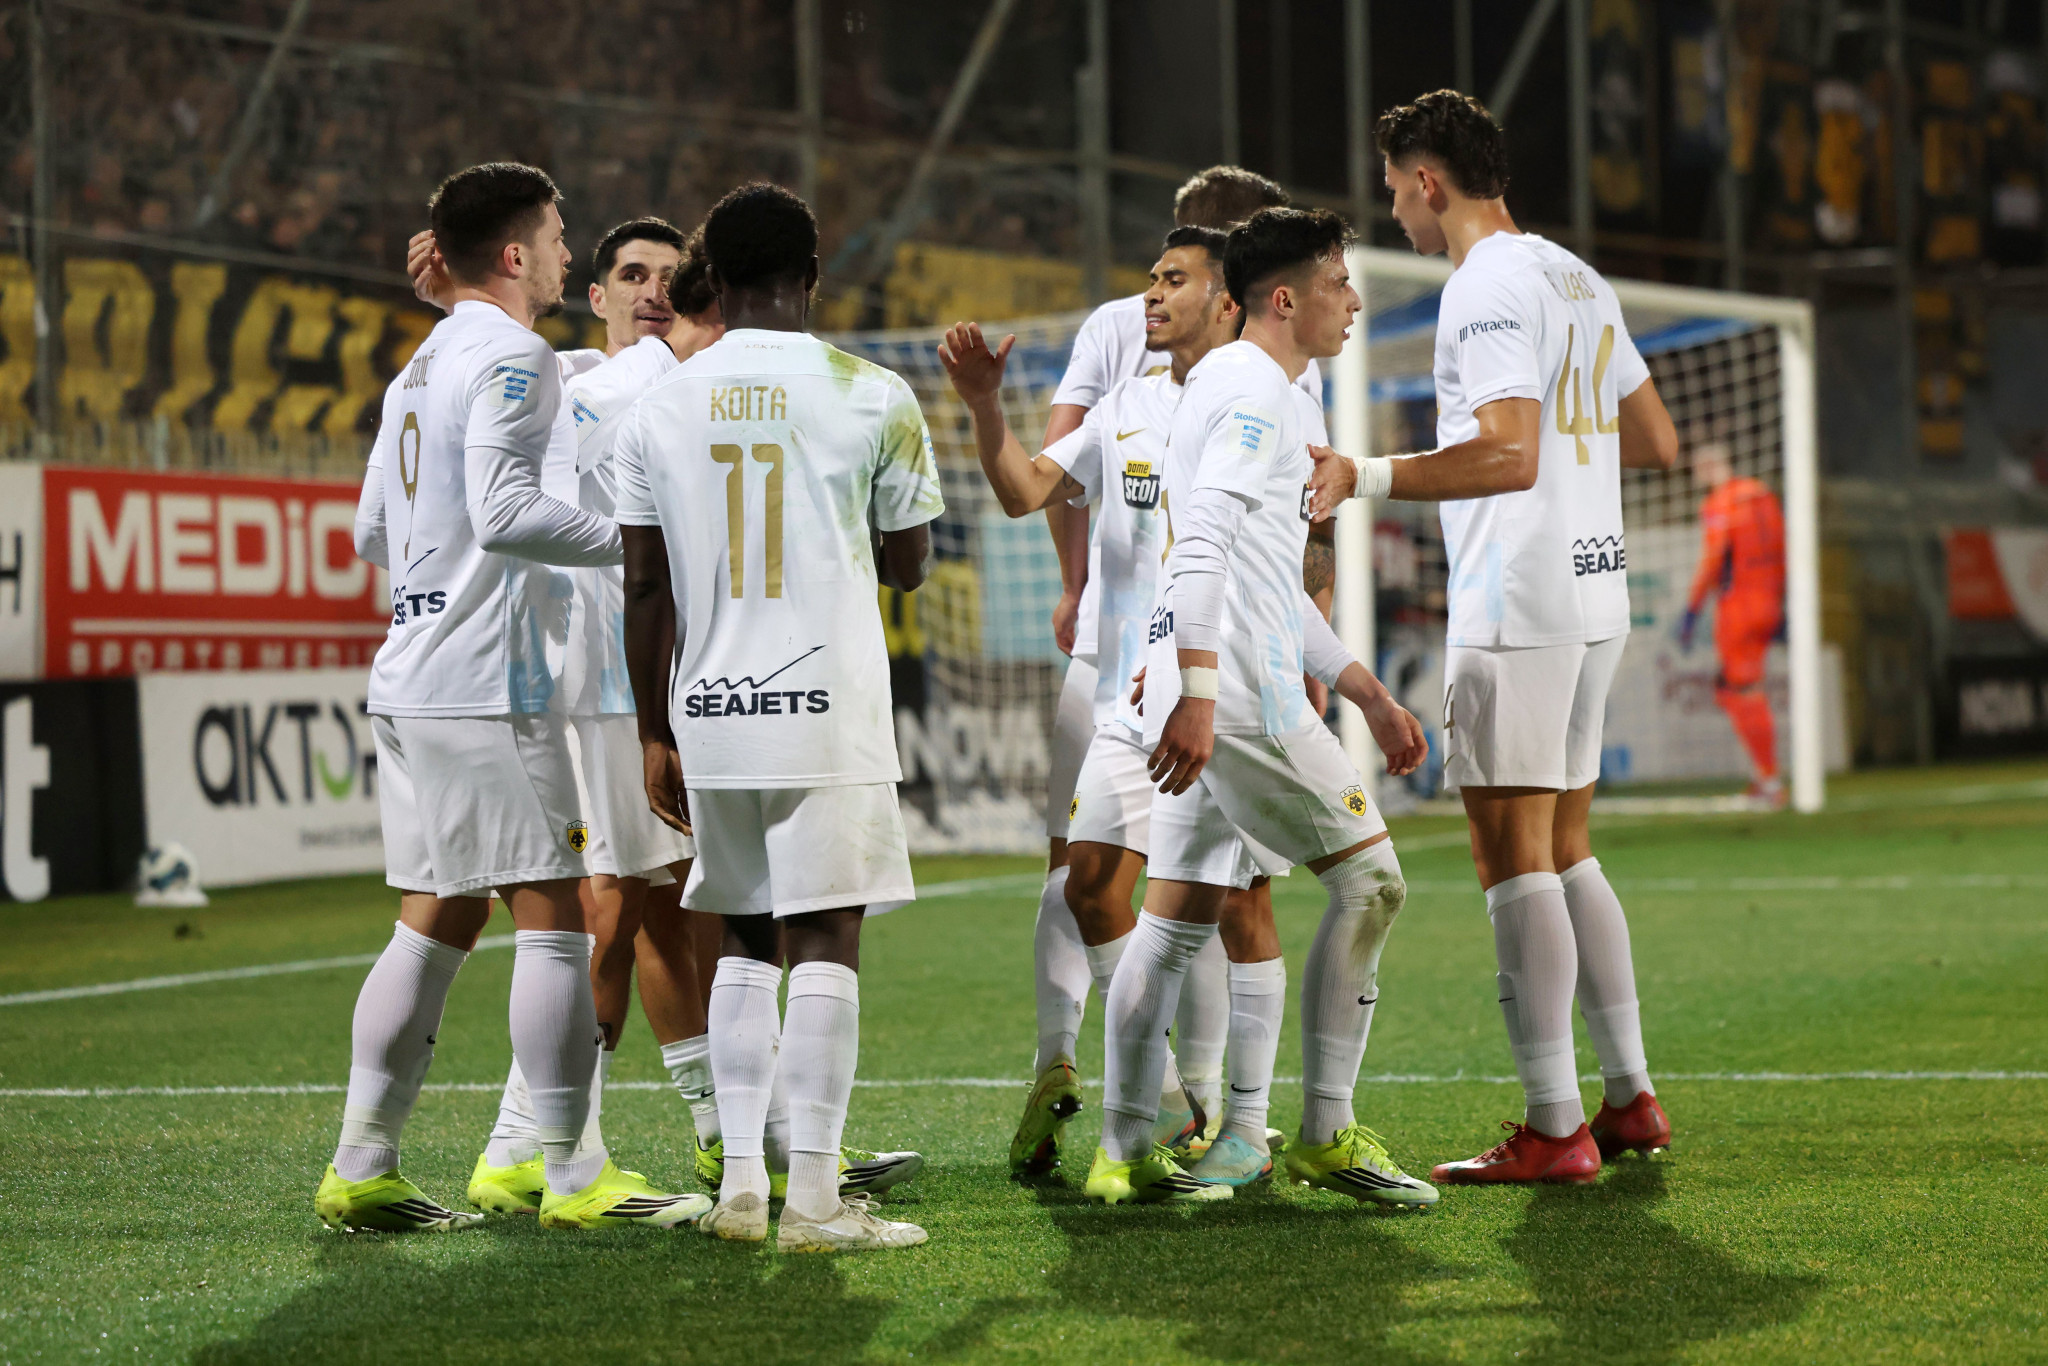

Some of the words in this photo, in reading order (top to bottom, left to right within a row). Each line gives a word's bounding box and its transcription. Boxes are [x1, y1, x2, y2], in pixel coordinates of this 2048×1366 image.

[1470, 320, 1521, 336] Piraeus
[710, 385, 787, 422] KOITA
[1233, 411, 1275, 430] Stoiximan
[1127, 462, 1150, 475] pame
[709, 443, 785, 599] 11
[68, 488, 393, 615] MEDiC
[1573, 548, 1626, 577] SEAJE
[684, 689, 830, 718] SEAJETS
